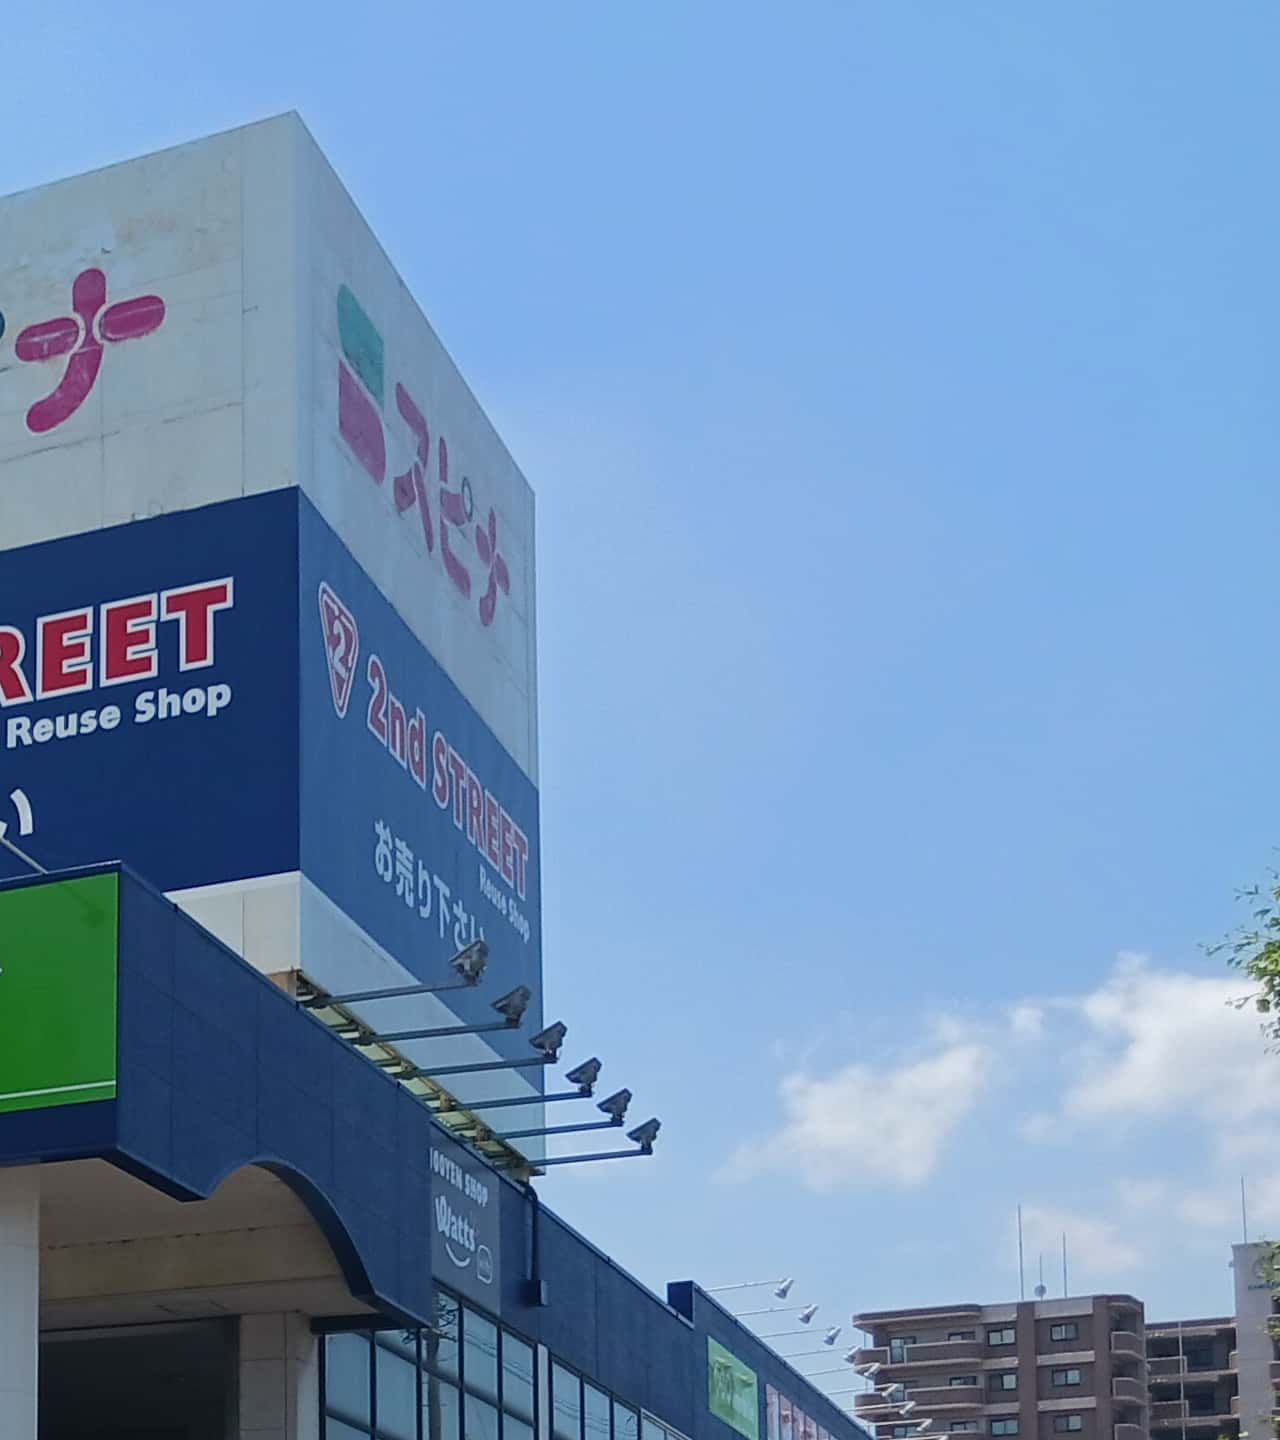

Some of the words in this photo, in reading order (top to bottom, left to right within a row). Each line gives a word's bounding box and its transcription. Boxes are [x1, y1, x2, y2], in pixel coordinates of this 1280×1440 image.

[393, 382, 511, 627] スピナ
[6, 704, 122, 748] Reuse
[134, 683, 232, 724] Shop
[367, 654, 426, 790] 2nd
[431, 731, 529, 900] STREET
[465, 1173, 489, 1208] SHOP
[435, 1195, 476, 1252] Watts
